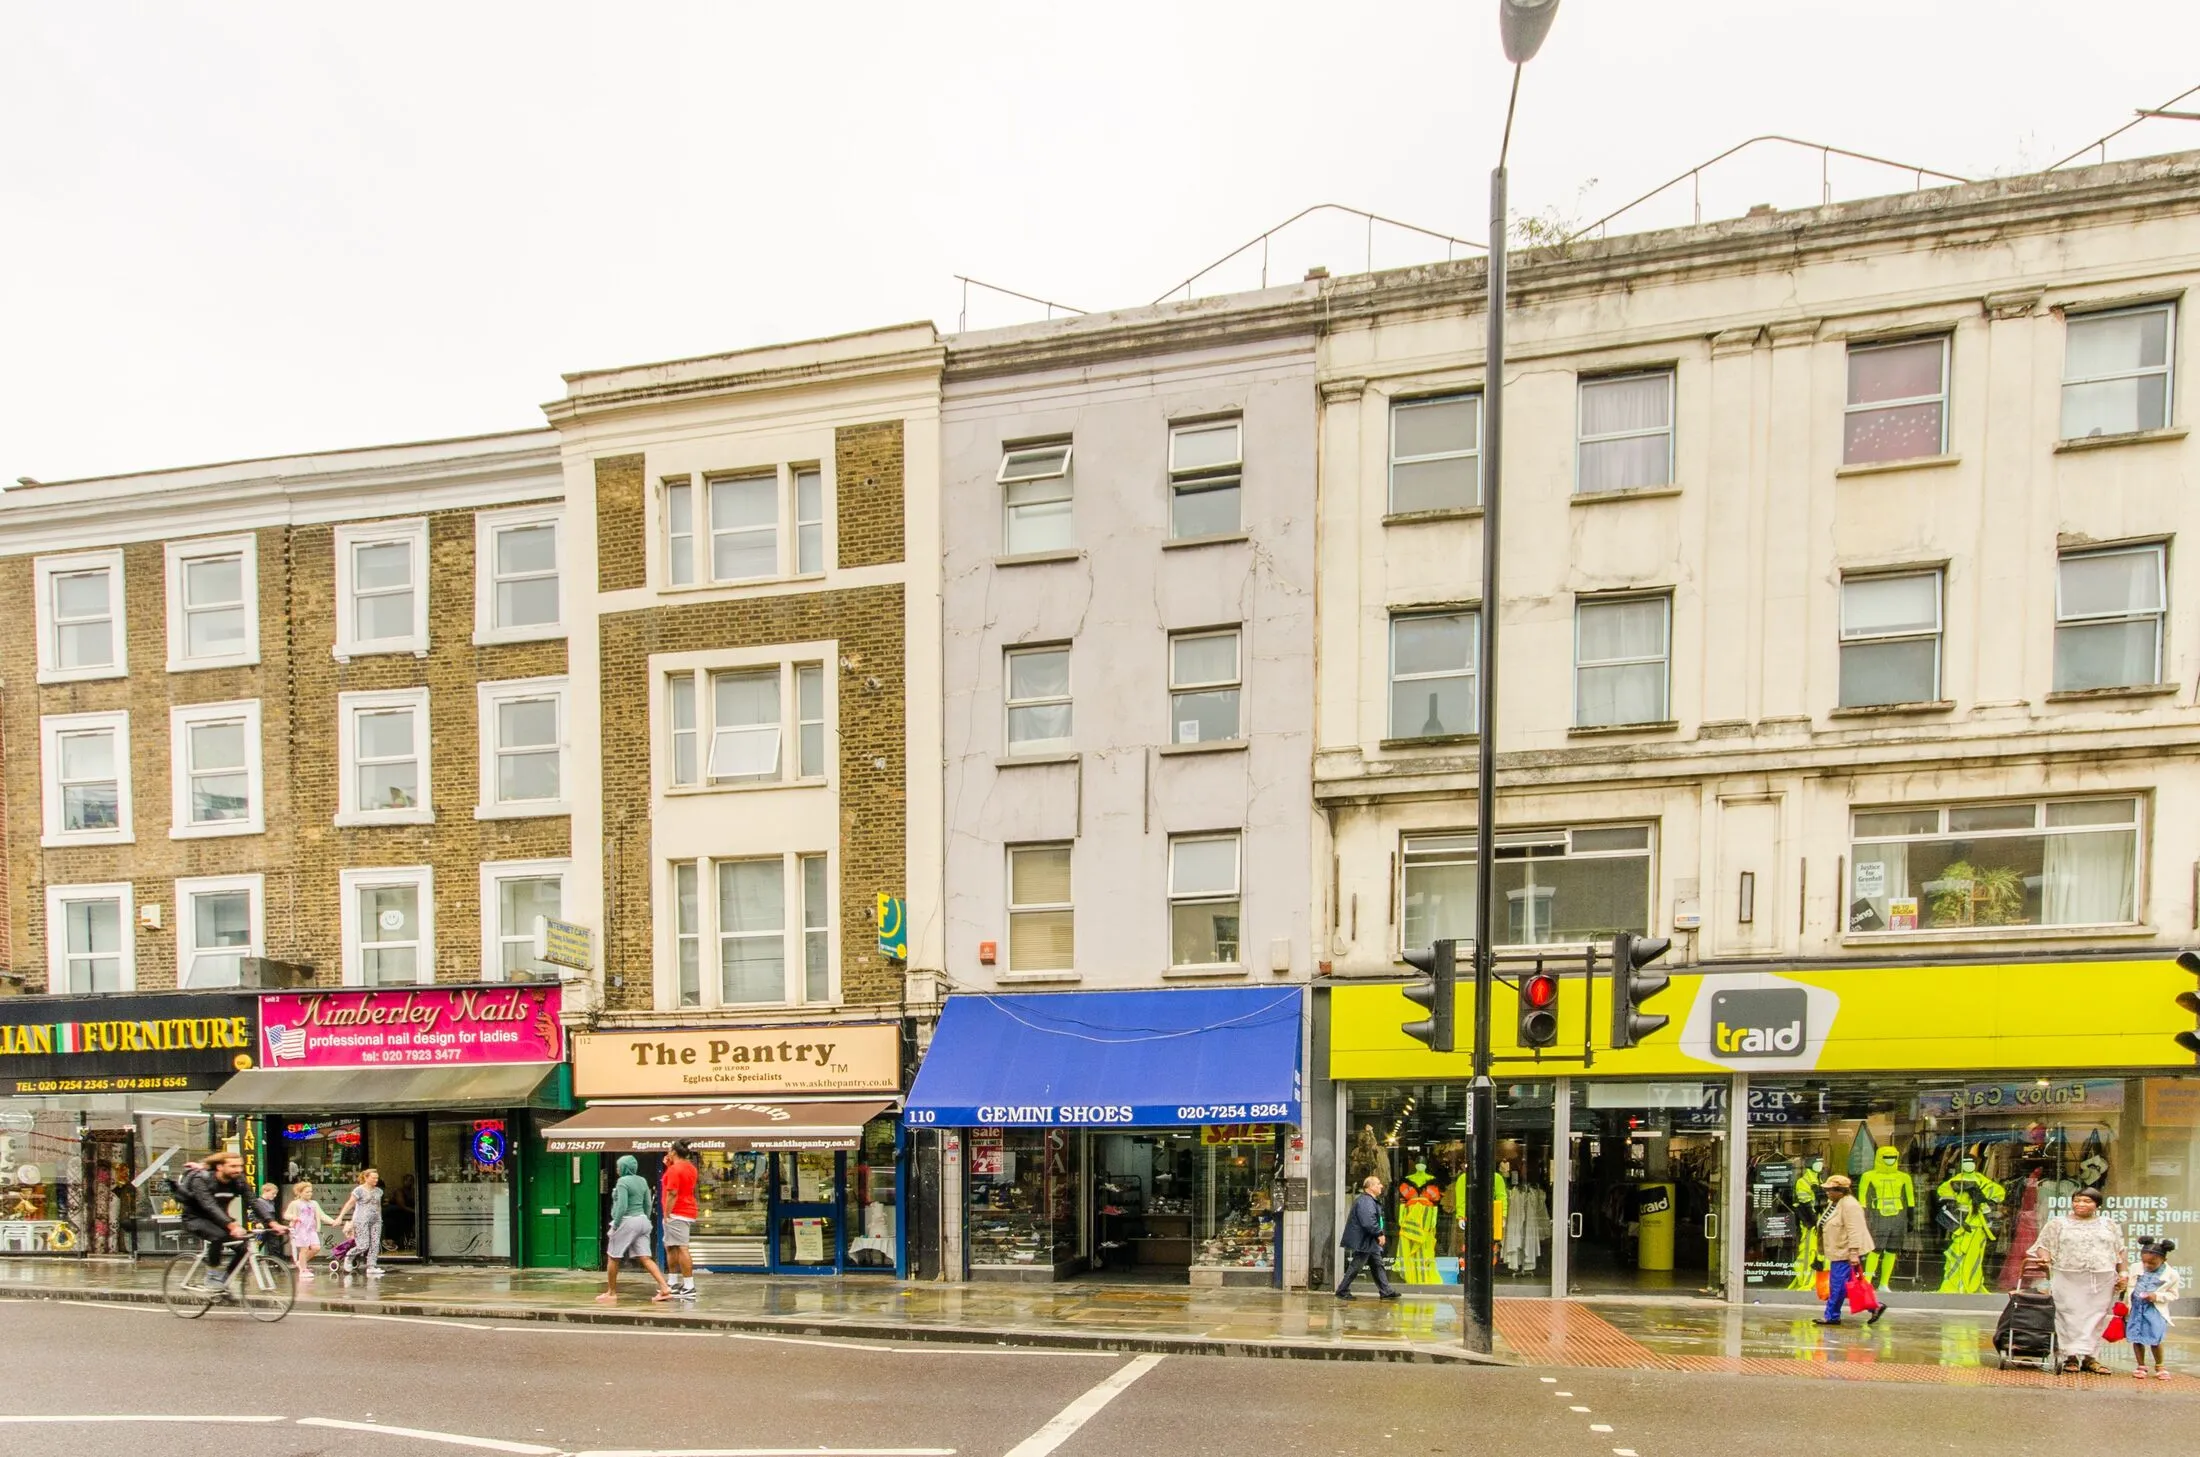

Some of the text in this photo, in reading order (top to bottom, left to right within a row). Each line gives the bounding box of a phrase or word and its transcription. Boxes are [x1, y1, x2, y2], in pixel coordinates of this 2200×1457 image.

[293, 989, 529, 1033] Kimberley Nails
[83, 1016, 248, 1051] FURNITURE
[310, 1029, 519, 1049] professional nail design for ladies
[1717, 1020, 1801, 1052] traid
[580, 1037, 592, 1045] 112
[362, 1049, 462, 1062] tel: 020 7923 3477
[631, 1040, 836, 1066] The Pantry
[830, 1063, 848, 1074] TM
[16, 1081, 36, 1092] TEL:
[38, 1080, 57, 1091] 020
[58, 1080, 82, 1090] 7254
[84, 1079, 108, 1089] 2345
[116, 1079, 136, 1089] 074
[162, 1077, 187, 1087] 6545
[683, 1073, 783, 1084] Eggless Cake Specialists
[784, 1077, 894, 1090] www.askthepantry.co.uk
[909, 1111, 936, 1123] 110
[977, 1103, 1288, 1123] GEMINI SHOES 020-7254 8264
[972, 1127, 1001, 1138] sale
[551, 1141, 566, 1150] 020
[567, 1141, 586, 1150] 7254
[587, 1141, 606, 1150] 5777
[632, 1140, 661, 1151] Eggless
[751, 1138, 856, 1150] www.askthepantry.co.uk
[2106, 1196, 2169, 1209] CLOTHES
[2132, 1209, 2200, 1223] IN-STORE
[2127, 1223, 2164, 1237] FREE
